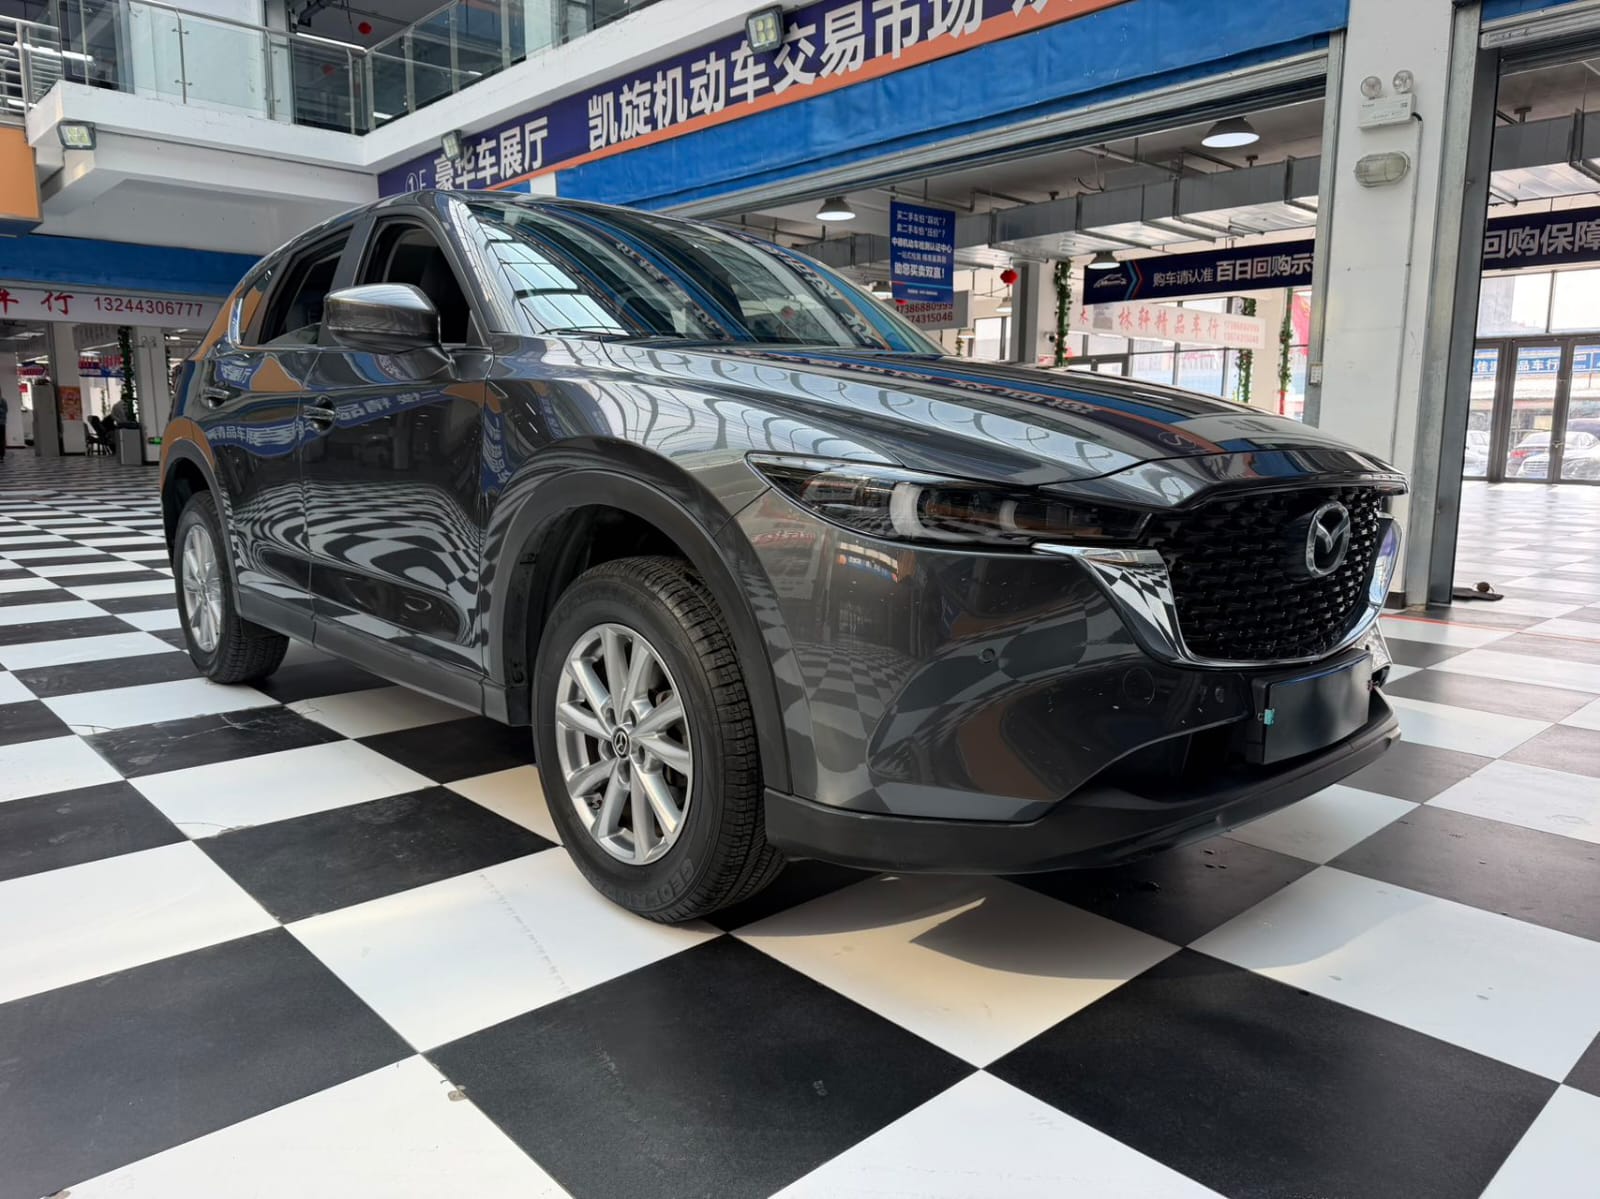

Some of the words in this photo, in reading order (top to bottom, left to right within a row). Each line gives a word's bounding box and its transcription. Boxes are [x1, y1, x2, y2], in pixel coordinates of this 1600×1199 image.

[588, 0, 983, 151] 凯旋机动车交易市场
[434, 116, 548, 191] 豪华车展厅
[1153, 267, 1213, 288] 购车请认准
[1216, 253, 1313, 282] 百日回购示
[94, 296, 203, 317] 13244306777
